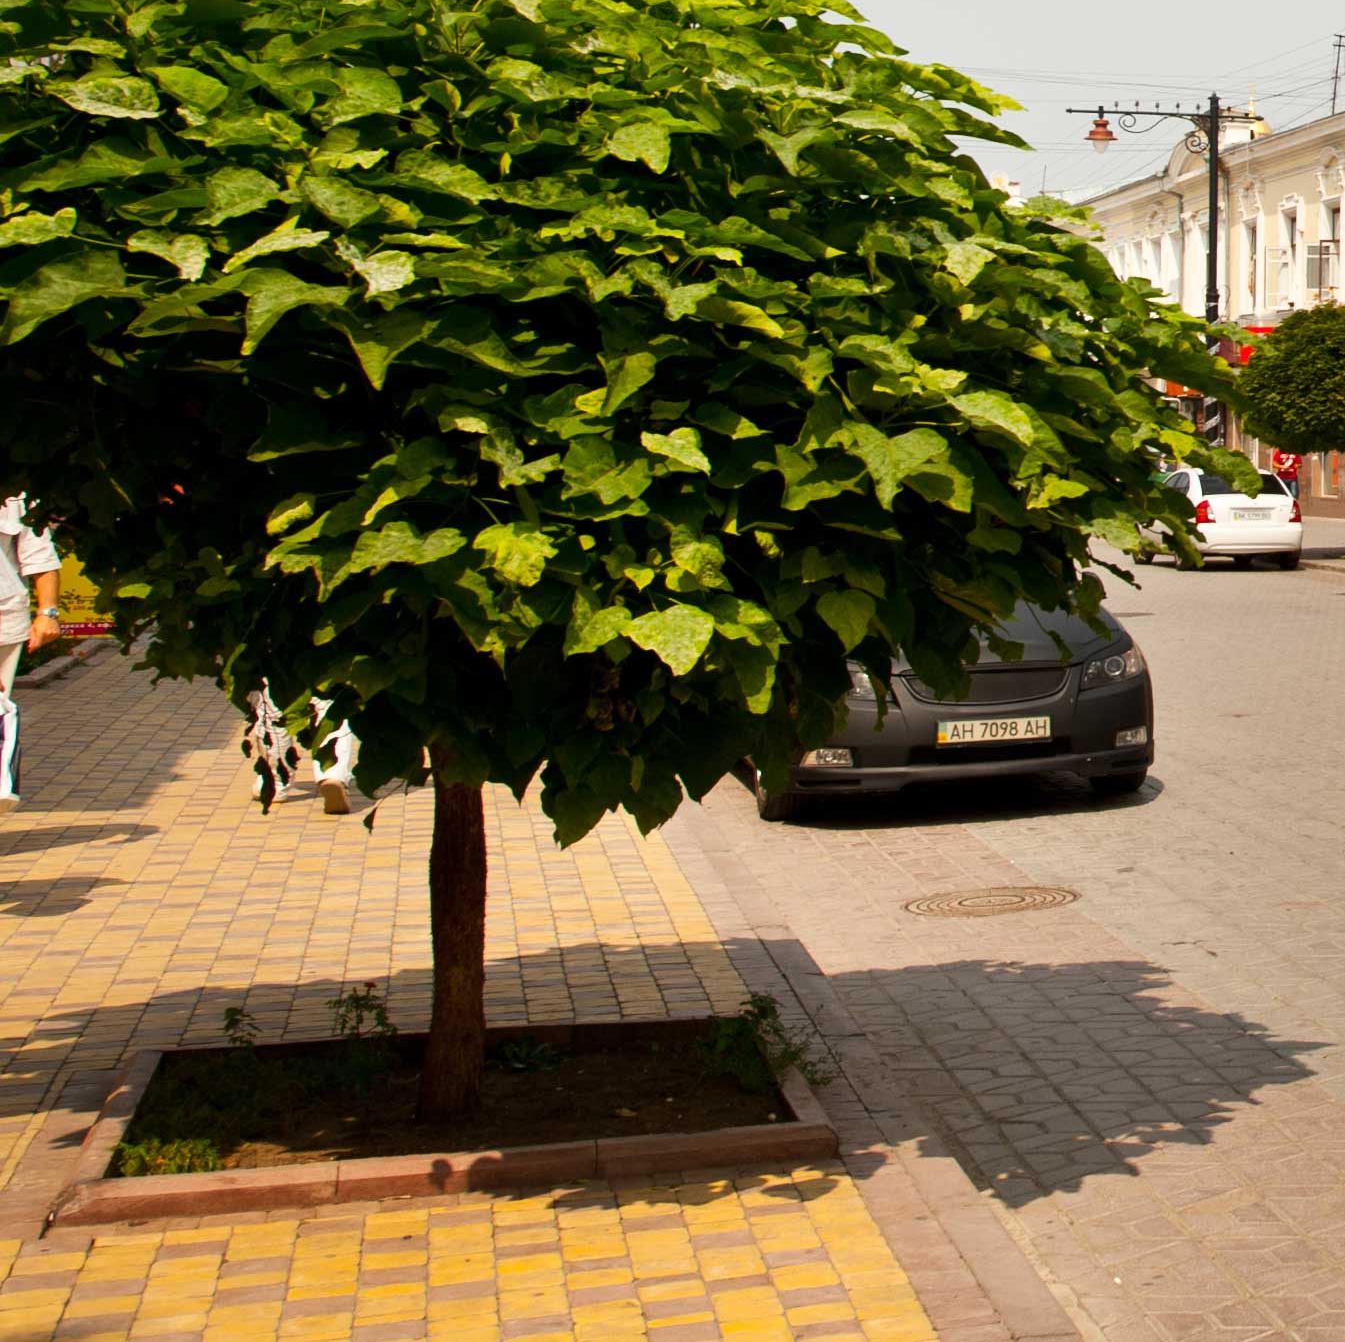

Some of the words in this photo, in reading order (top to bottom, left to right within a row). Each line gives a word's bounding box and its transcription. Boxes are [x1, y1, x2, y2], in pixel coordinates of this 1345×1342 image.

[950, 723, 974, 740] AH
[980, 721, 1018, 738] 7098
[1024, 719, 1047, 737] AH
